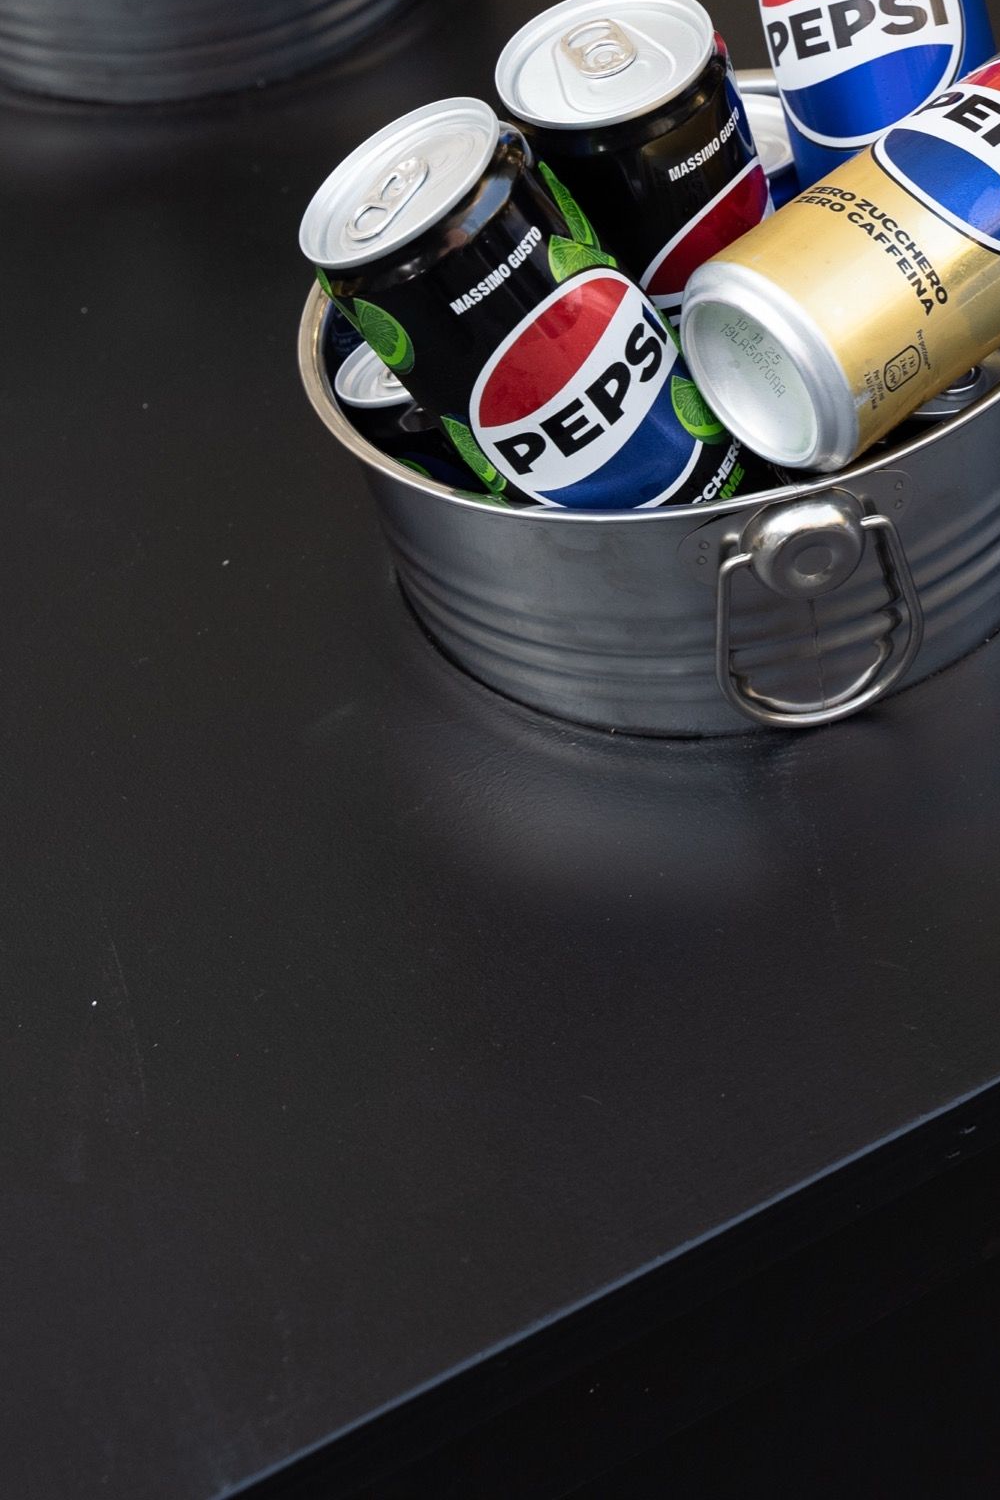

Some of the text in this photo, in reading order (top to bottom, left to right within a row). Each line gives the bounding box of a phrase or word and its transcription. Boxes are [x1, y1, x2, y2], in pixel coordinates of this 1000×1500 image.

[668, 106, 740, 182] MASSIMO GUSTO
[449, 226, 542, 315] MASSIMO GUSTO
[795, 195, 935, 316] ZERO CAFFEINA
[807, 186, 948, 304] ZERO ZUCCHERO
[493, 303, 668, 475] PEPSI
